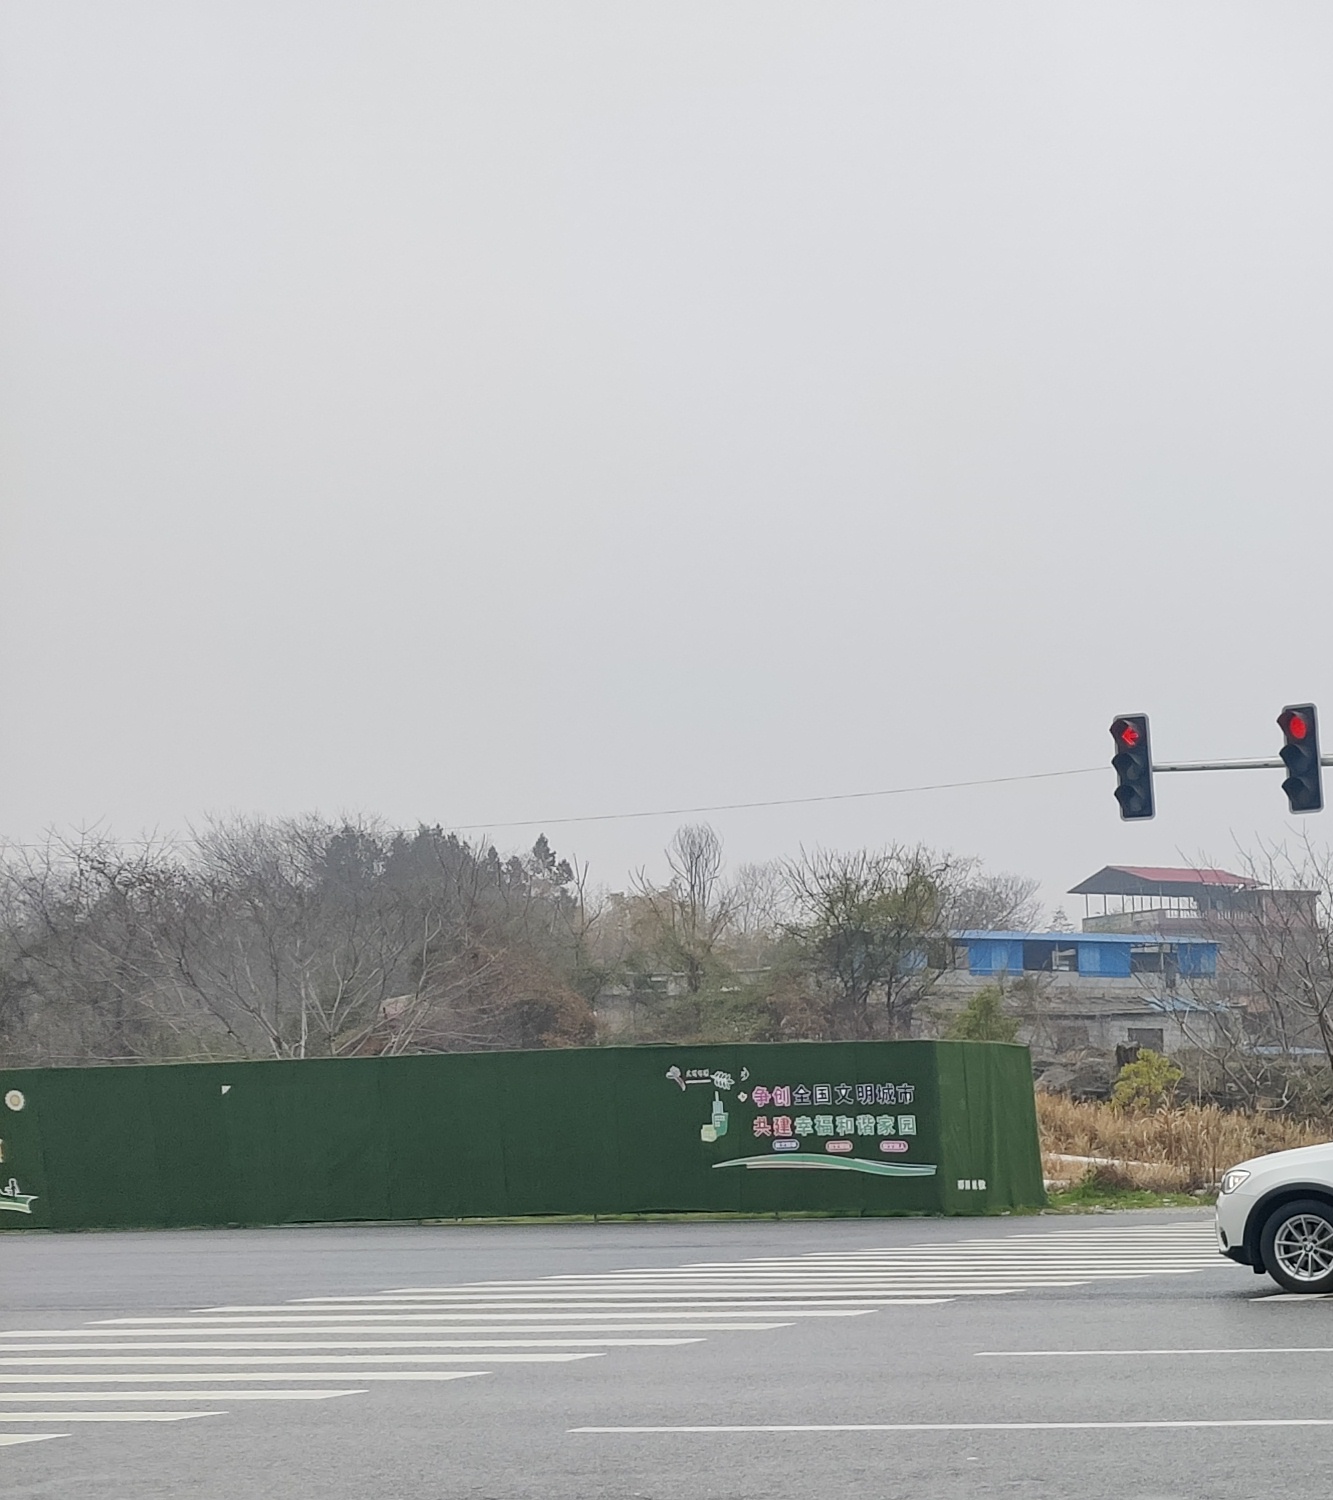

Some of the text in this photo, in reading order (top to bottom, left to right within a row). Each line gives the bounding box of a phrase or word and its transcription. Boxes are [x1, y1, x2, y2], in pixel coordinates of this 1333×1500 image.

[752, 1083, 915, 1107] 争创全国文明城市
[753, 1115, 917, 1137] 共建幸福和谐家园
